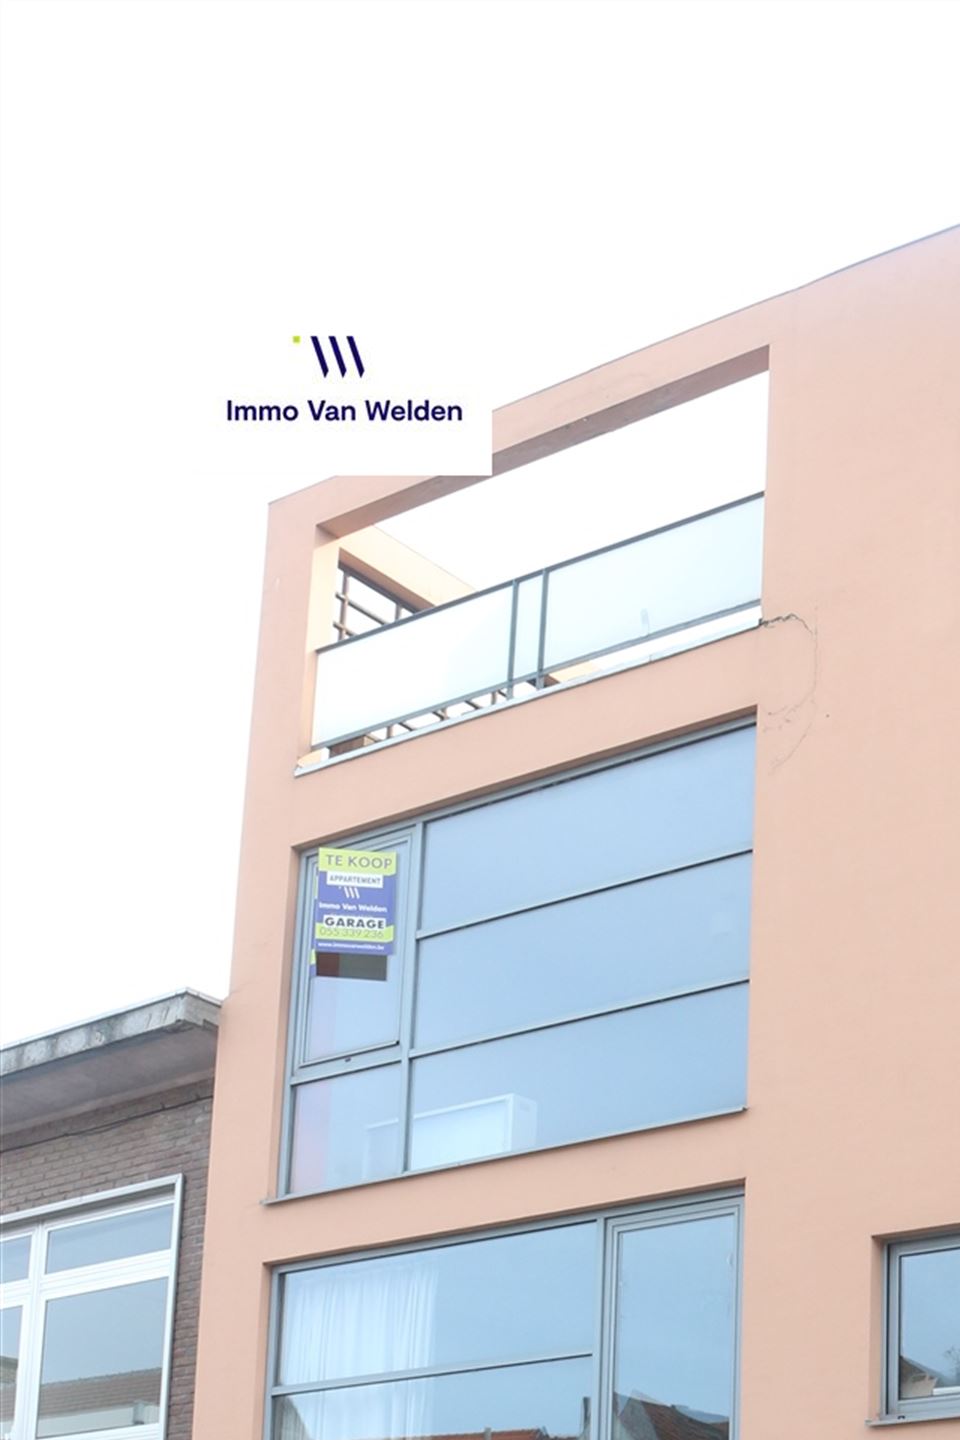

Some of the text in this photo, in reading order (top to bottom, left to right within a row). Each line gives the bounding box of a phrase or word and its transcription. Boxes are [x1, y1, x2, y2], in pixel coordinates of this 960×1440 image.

[326, 854, 392, 869] TE KOOP
[329, 874, 381, 885] APPARTEMENT
[319, 902, 388, 912] Immo Van Welden
[324, 916, 384, 929] GARAGE
